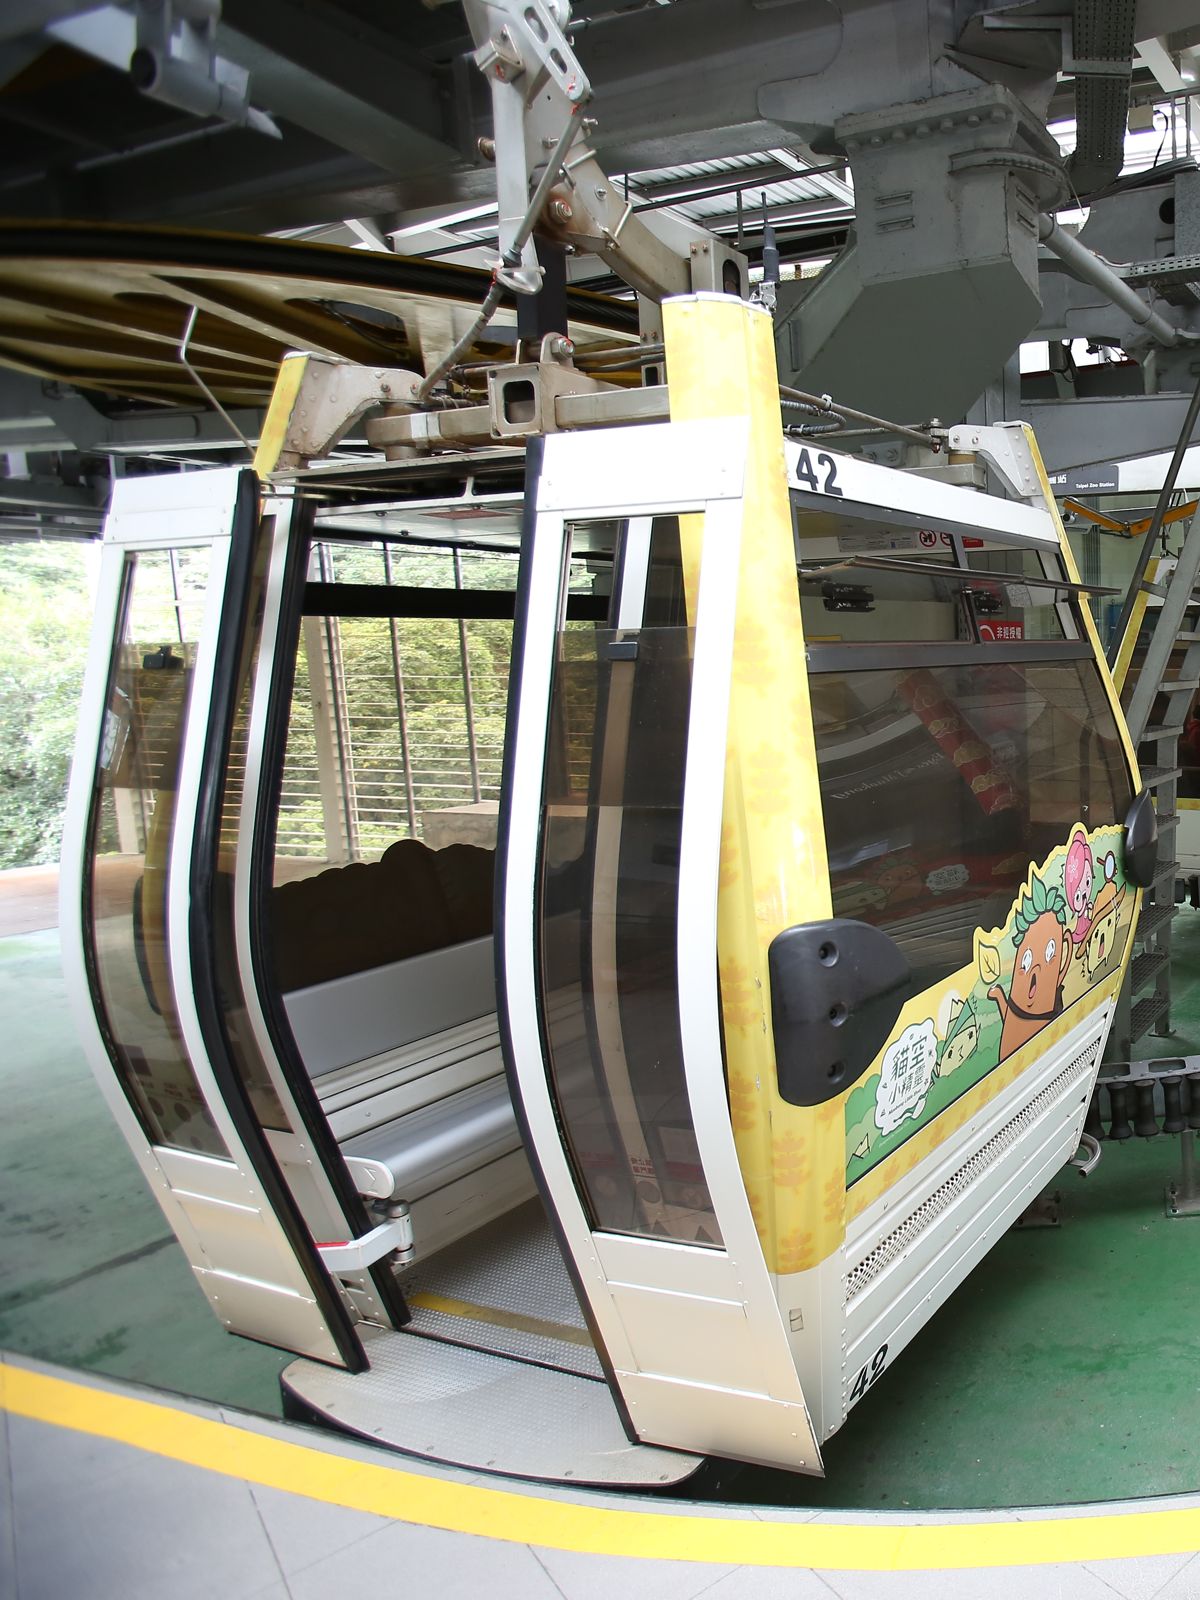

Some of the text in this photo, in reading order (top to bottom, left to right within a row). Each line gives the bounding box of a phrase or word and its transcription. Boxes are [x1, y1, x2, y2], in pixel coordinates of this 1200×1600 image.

[796, 448, 843, 497] 42
[890, 1035, 928, 1082] 貓空
[888, 1062, 926, 1105] 小精靈
[849, 1343, 889, 1402] 42
